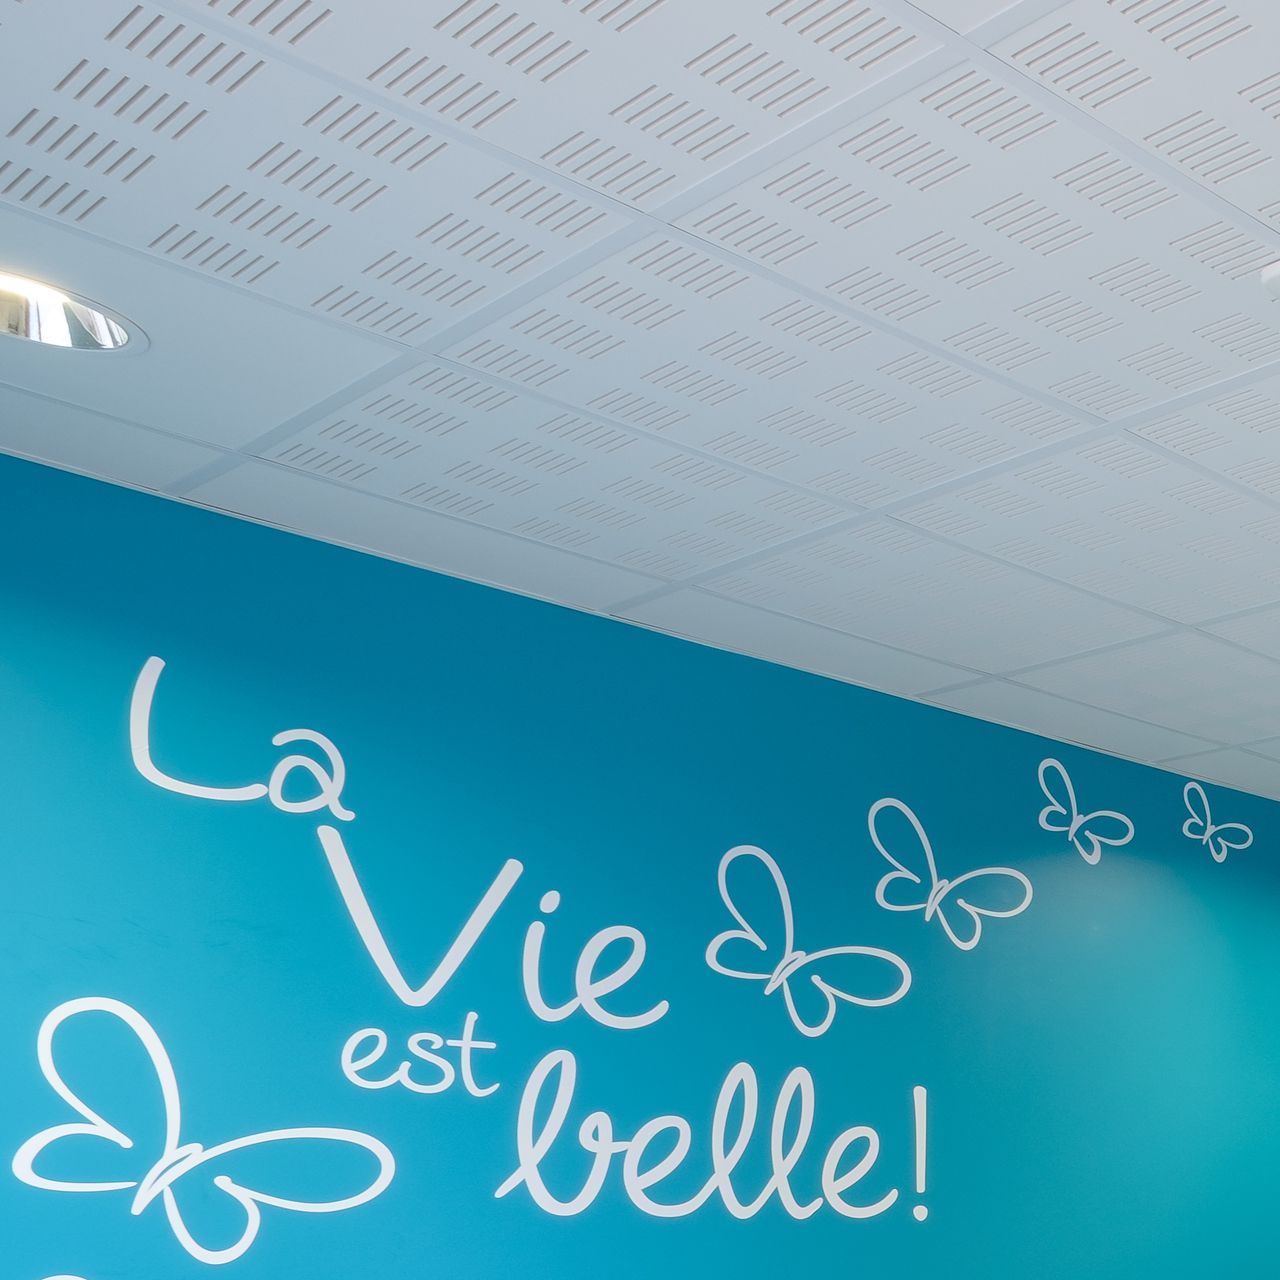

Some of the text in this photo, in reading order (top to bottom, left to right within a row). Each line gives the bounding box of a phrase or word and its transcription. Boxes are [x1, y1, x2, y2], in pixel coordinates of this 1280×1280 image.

[130, 656, 356, 821] La
[317, 825, 669, 1030] Vie
[341, 1011, 500, 1098] est
[494, 1049, 928, 1222] belle!
